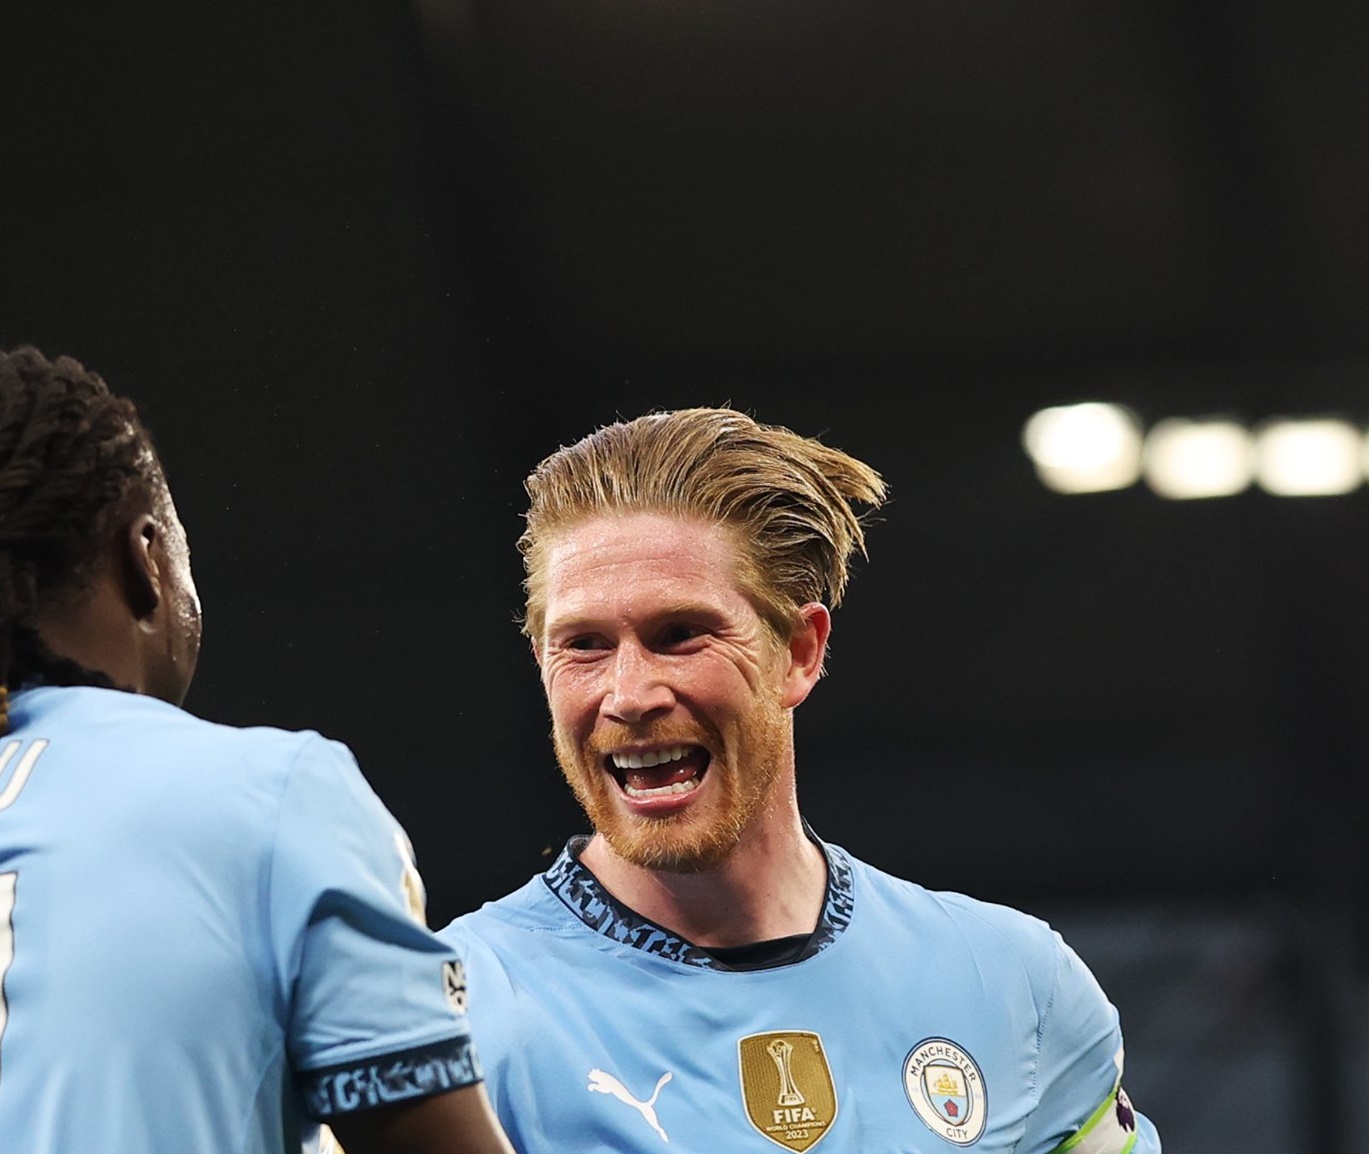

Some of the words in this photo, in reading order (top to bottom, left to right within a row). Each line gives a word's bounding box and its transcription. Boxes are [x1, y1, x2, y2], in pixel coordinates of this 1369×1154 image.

[910, 1047, 977, 1081] MANCHESTER
[773, 1107, 815, 1124] FIFA
[789, 1121, 826, 1130] CHAMPIONS
[785, 1130, 809, 1140] 2023
[946, 1127, 968, 1140] CITY
